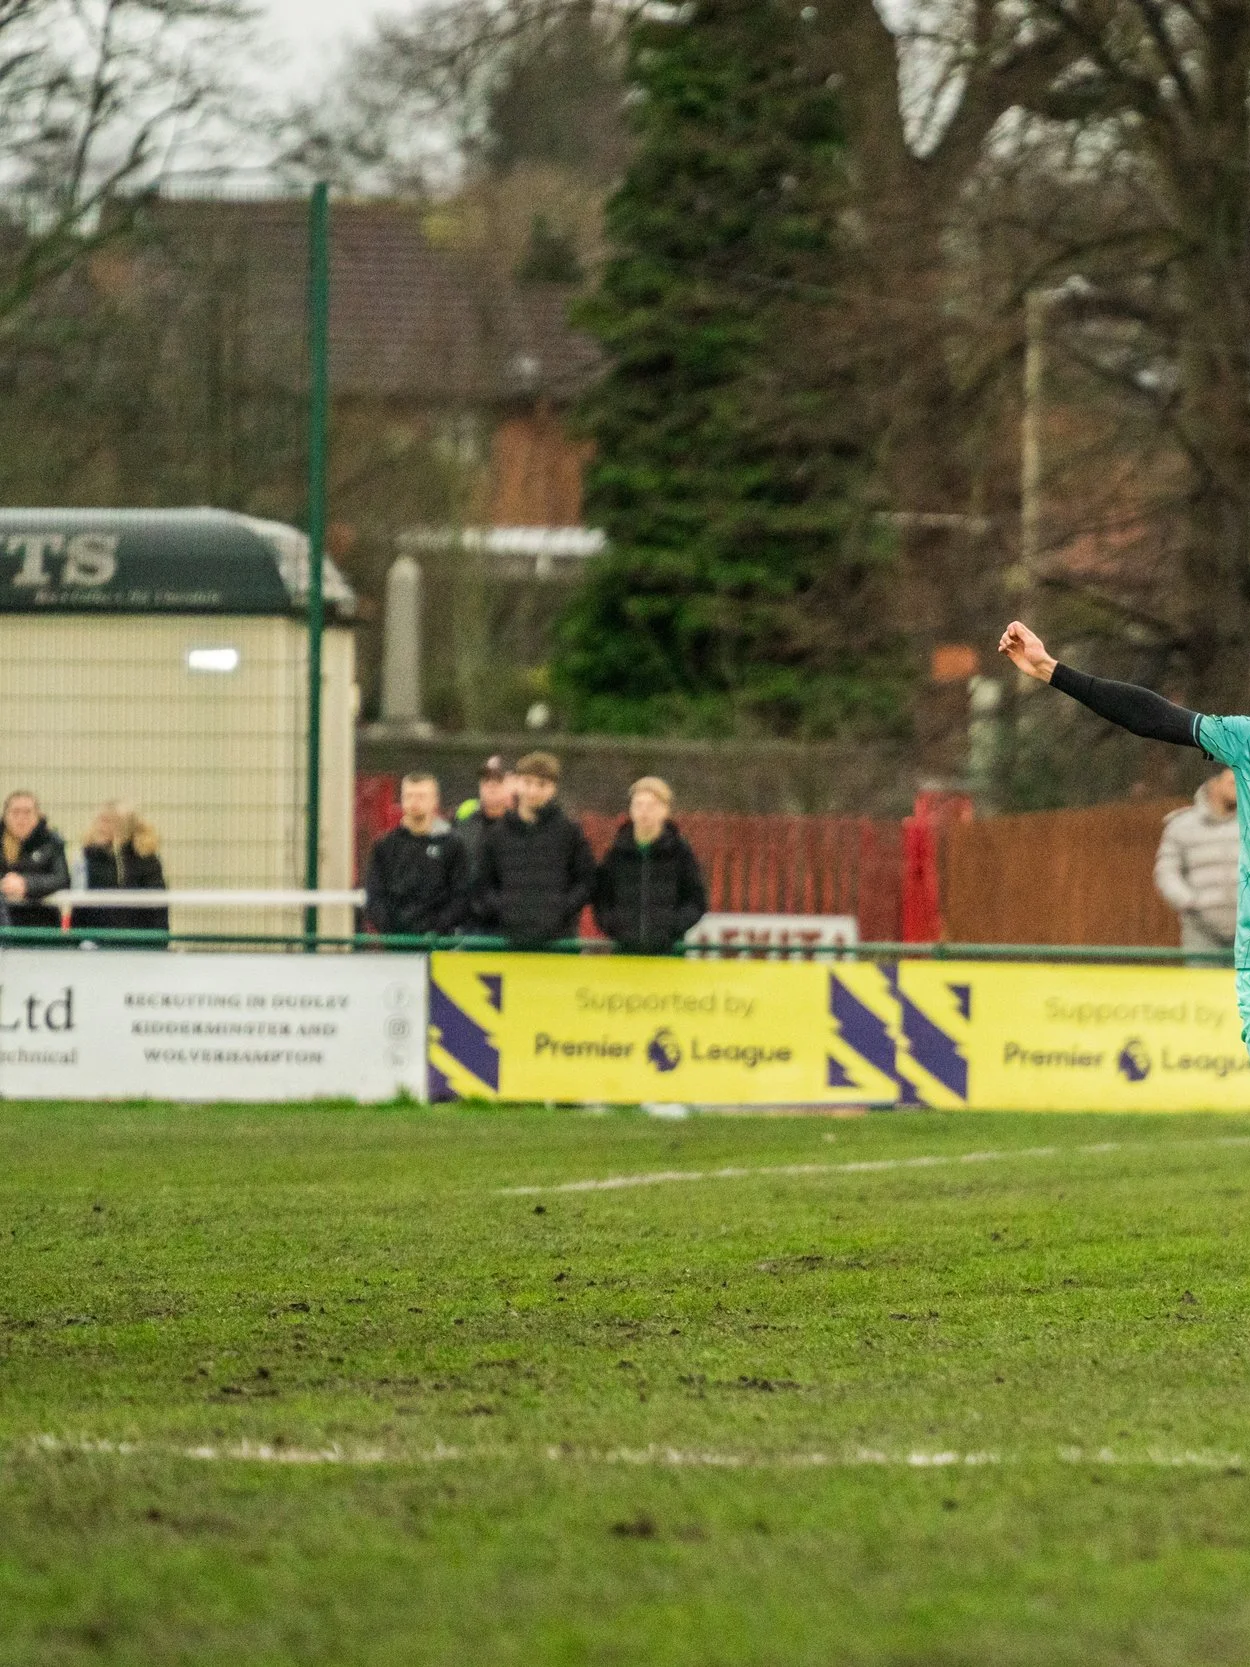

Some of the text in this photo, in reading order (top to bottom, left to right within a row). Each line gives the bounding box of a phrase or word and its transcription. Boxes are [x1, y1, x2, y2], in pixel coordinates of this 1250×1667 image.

[0, 533, 118, 587] TS
[123, 992, 349, 1009] RECRUITING IN DUDLEY
[574, 987, 756, 1018] Supported by
[1044, 995, 1227, 1028] Supported by
[131, 1020, 338, 1036] KIDDERMINSTER AND
[143, 1049, 324, 1065] WOLVERHAMPTON
[533, 1034, 792, 1067] Premier League
[1003, 1041, 1105, 1070] Premier
